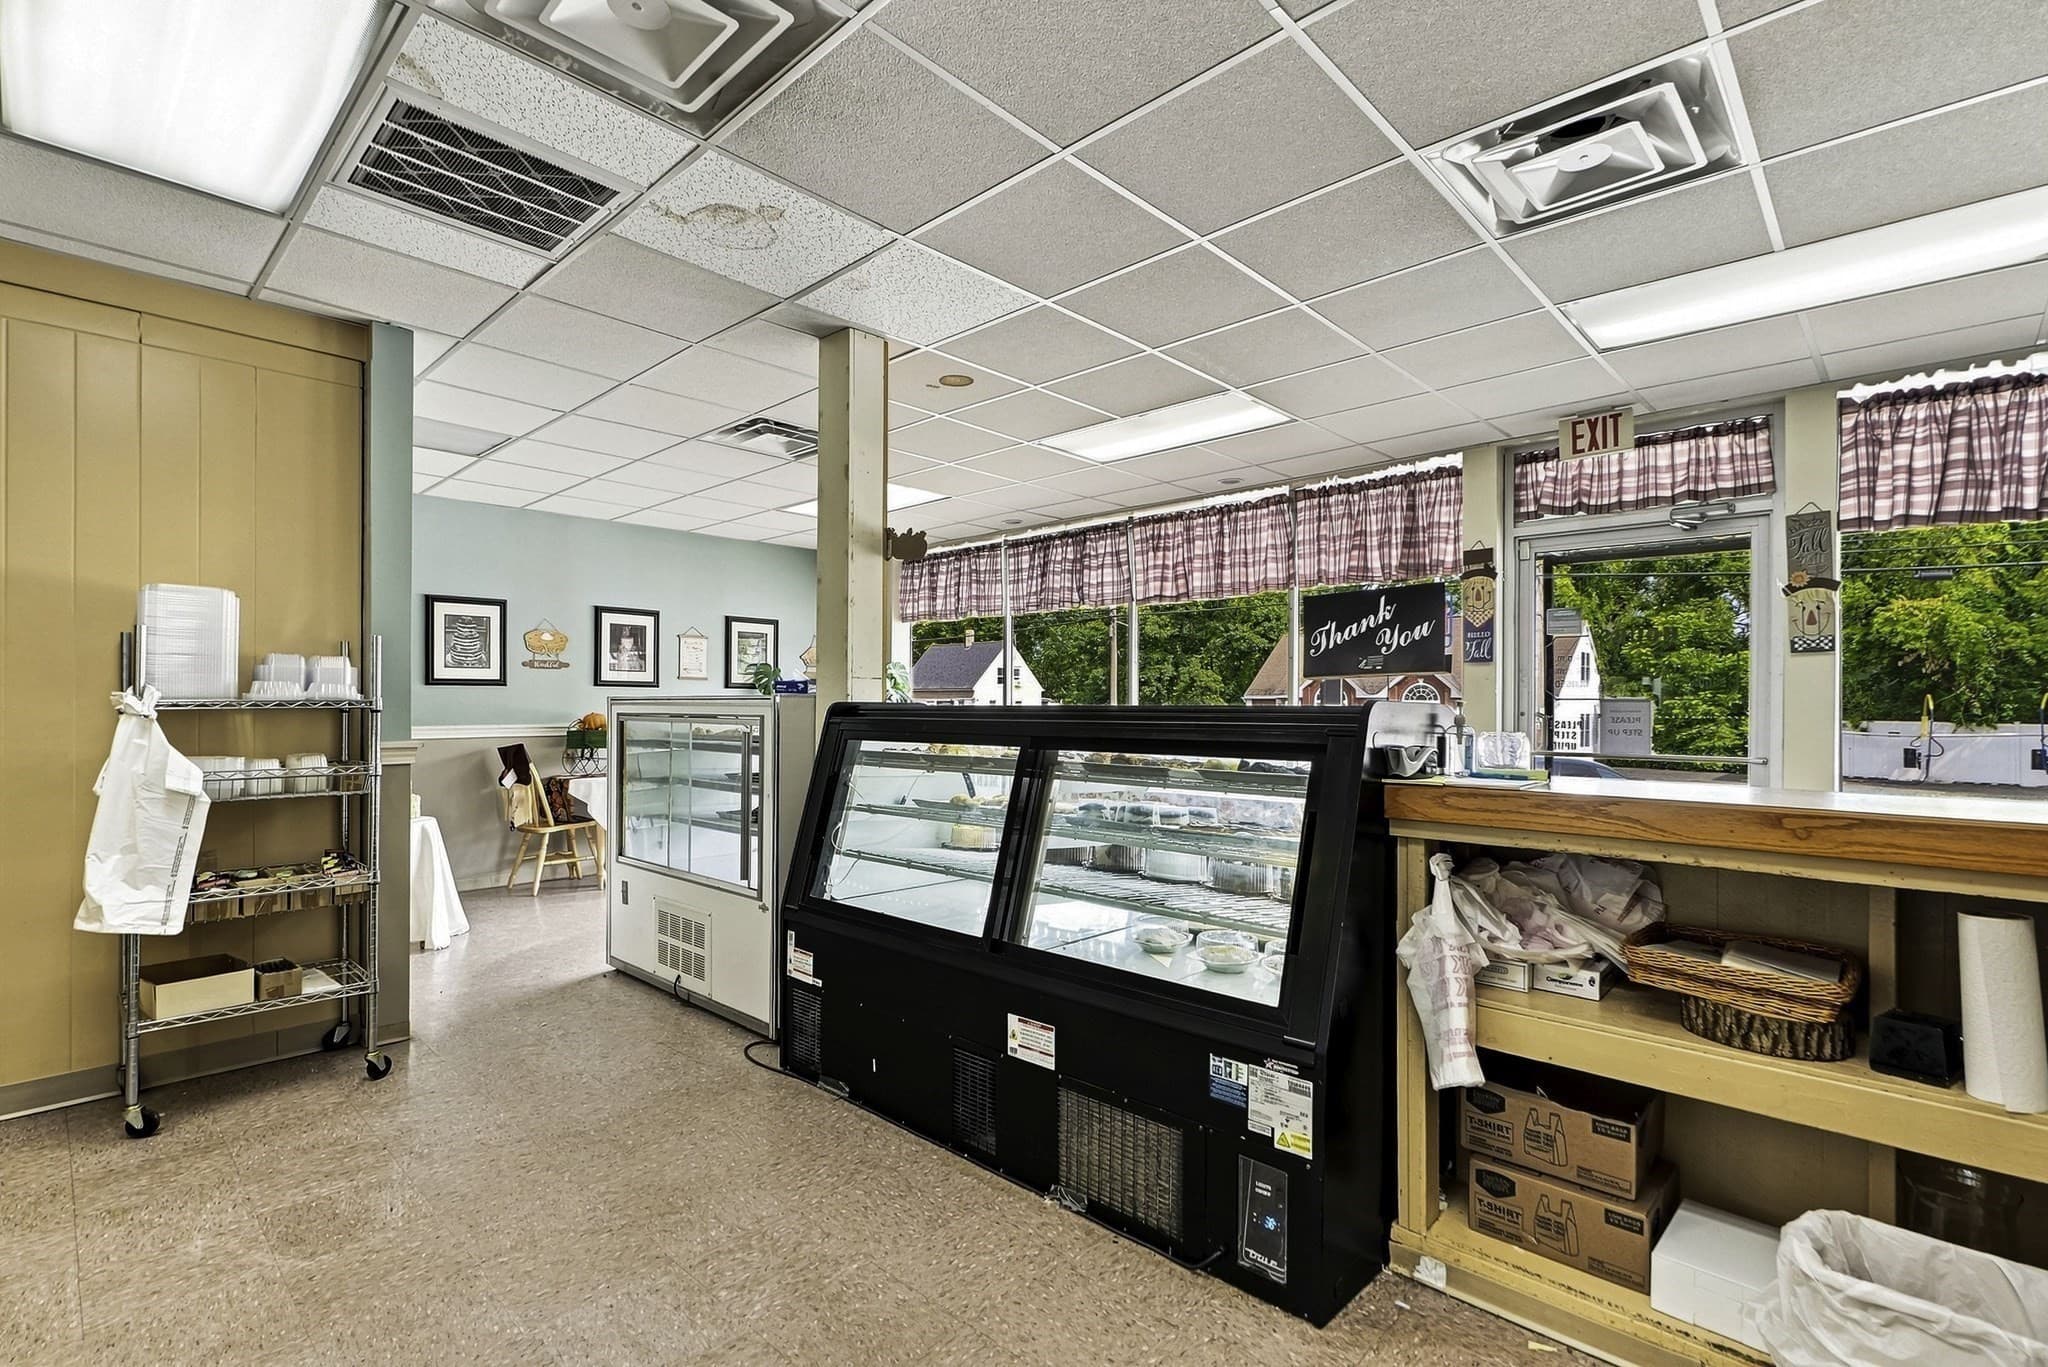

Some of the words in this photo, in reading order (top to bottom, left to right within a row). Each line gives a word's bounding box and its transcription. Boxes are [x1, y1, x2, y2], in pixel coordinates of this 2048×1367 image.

[1571, 412, 1623, 455] EXIT
[1309, 595, 1397, 657] Thank
[1375, 619, 1436, 655] You
[1465, 637, 1491, 660] Fall
[1467, 1115, 1512, 1134] T-SHIRT
[1477, 1197, 1523, 1219] T-SHIRT
